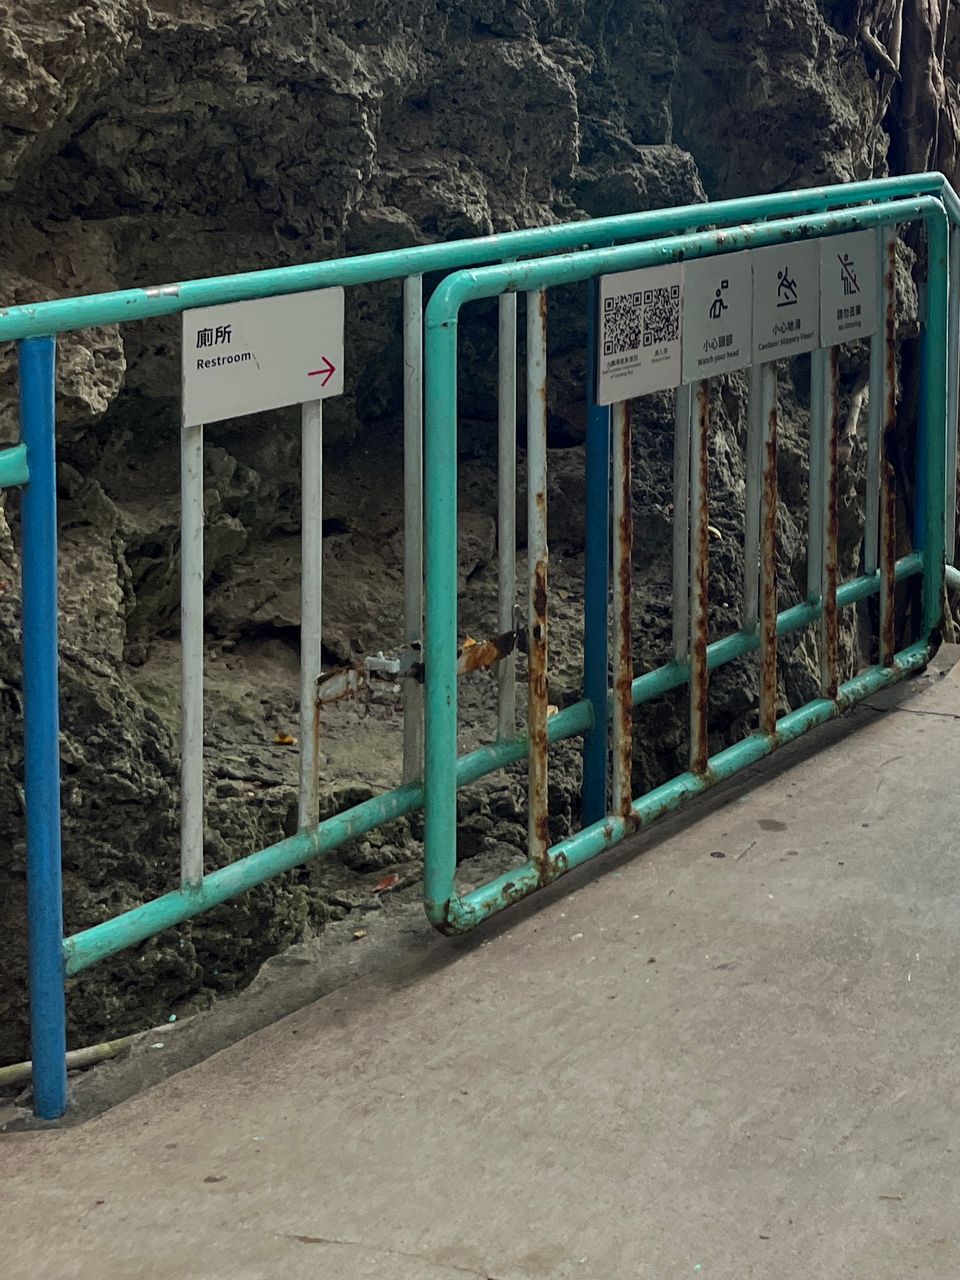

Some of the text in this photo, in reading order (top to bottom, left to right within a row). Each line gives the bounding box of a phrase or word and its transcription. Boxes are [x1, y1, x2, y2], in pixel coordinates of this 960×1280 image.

[196, 324, 232, 349] 廁所
[702, 333, 733, 353] 小心頭部
[197, 351, 251, 370] Restroom
[726, 348, 740, 358] head
